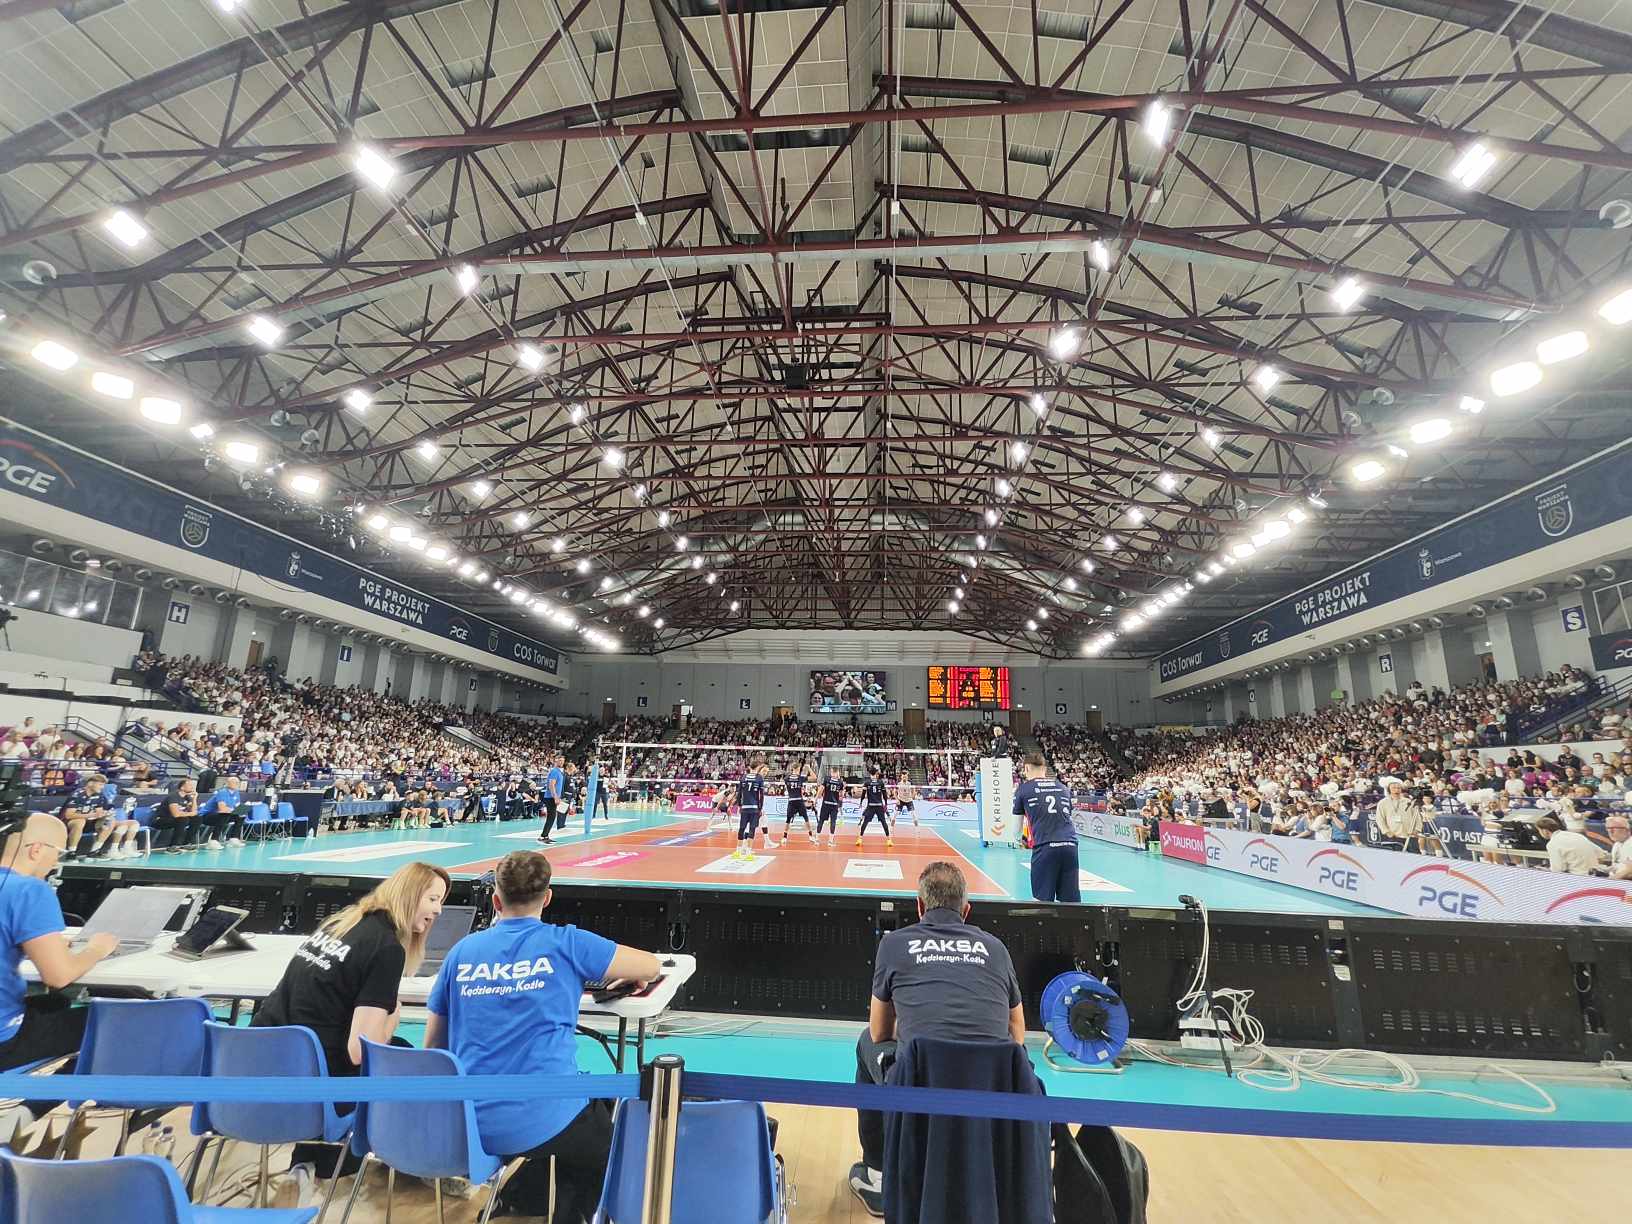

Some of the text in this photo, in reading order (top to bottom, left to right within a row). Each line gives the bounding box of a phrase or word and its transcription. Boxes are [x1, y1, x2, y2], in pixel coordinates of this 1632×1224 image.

[359, 577, 430, 614] PGE PROJEKT
[1295, 572, 1370, 614] PGE PROJEKT
[172, 608, 187, 623] H
[364, 593, 423, 624] WARSZAWA
[1301, 591, 1368, 625] WARSZAWA
[1566, 611, 1583, 631] S
[450, 626, 469, 640] PGE
[1251, 628, 1269, 646] PGE
[514, 643, 557, 669] COS Torwar
[1615, 648, 1632, 661] PG
[1161, 651, 1203, 677] COS Torwar
[1381, 658, 1391, 673] R
[886, 702, 896, 711] M
[984, 711, 993, 720] N
[1056, 704, 1065, 714] O
[696, 801, 713, 809] TAU
[1045, 795, 1057, 814] 2
[936, 810, 959, 818] PGE
[1114, 821, 1130, 837] plus
[1454, 830, 1482, 844] PLAST
[1172, 835, 1204, 851] TAURON
[1207, 846, 1221, 861] GE
[1250, 854, 1279, 874] PGE
[1319, 867, 1359, 892] PGE
[1418, 885, 1480, 918] PGE
[908, 939, 989, 957] ZAKSA
[456, 957, 554, 981] ZAKSA
